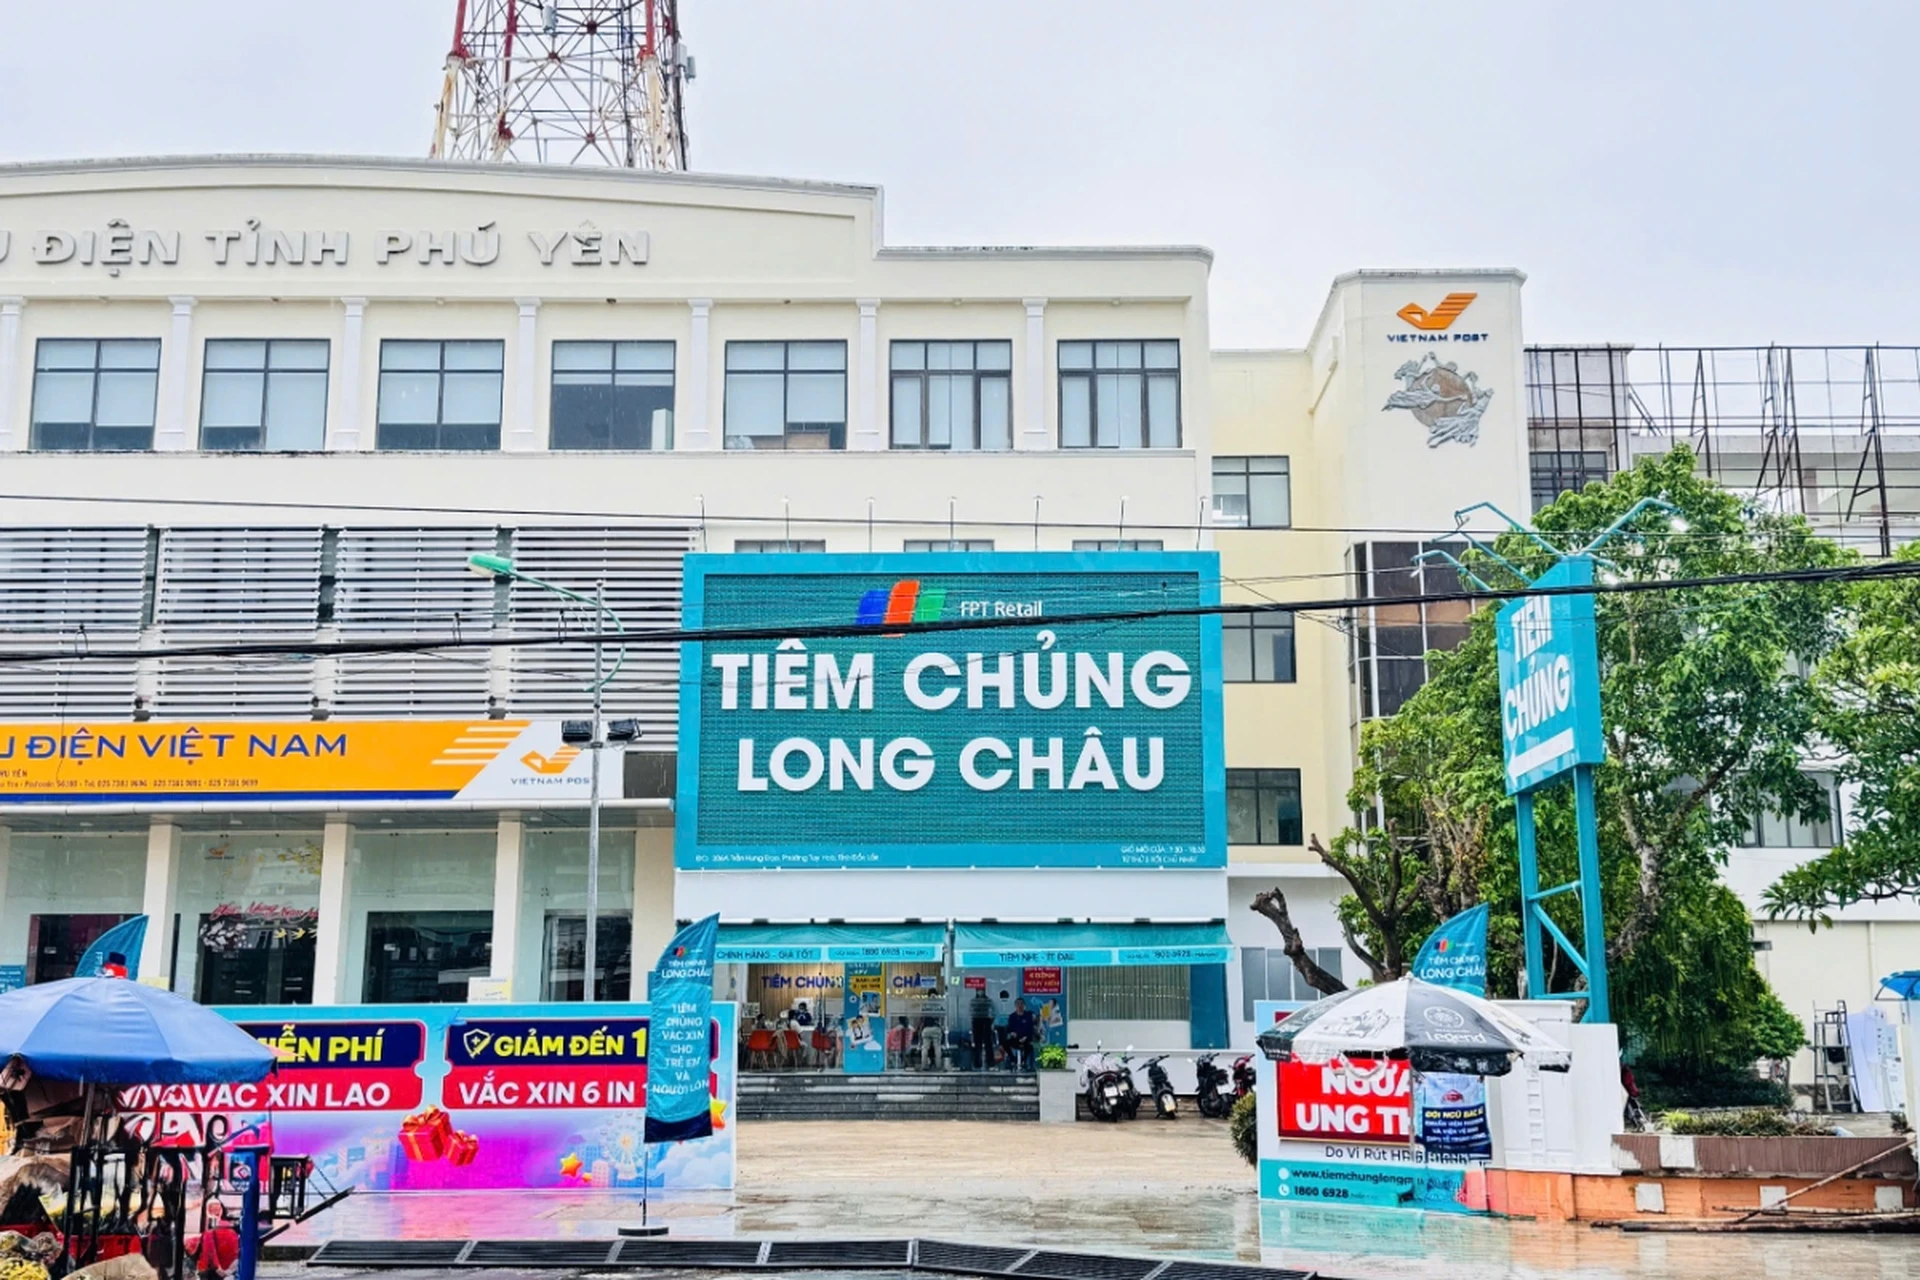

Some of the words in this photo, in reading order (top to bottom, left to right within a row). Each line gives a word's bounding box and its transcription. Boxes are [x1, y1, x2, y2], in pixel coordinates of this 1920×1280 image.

[32, 218, 180, 277] ĐIỆN
[205, 217, 349, 266] TỈNH
[375, 221, 500, 266] PHÚ
[1386, 333, 1449, 343] VIETNAM
[1453, 333, 1489, 342] POST
[960, 601, 988, 617] FPT
[994, 600, 1042, 617] Retail
[711, 638, 874, 710] TIÊM
[903, 630, 1192, 710] CHỦNG
[1504, 654, 1570, 741] CHỦNG
[25, 727, 126, 765] ĐIỆN
[137, 727, 235, 765] VIỆT
[248, 733, 347, 757] NAM
[737, 737, 936, 791] LONG
[959, 726, 1164, 791] CHÂU
[511, 777, 563, 785] VIETNAM
[761, 973, 792, 988] TIÊM
[1420, 968, 1454, 980] LONG
[328, 1028, 386, 1062] PHÍ
[494, 1028, 564, 1057] GIẢM
[568, 1026, 624, 1056] ĐẾN
[670, 1044, 693, 1054] CHO
[1425, 1031, 1487, 1044] Legend
[265, 1083, 318, 1106] XIN
[325, 1082, 391, 1106] LAO
[459, 1070, 520, 1105] VẮC
[527, 1081, 577, 1105] XIN
[582, 1081, 601, 1104] 6
[607, 1081, 635, 1104] IN
[1295, 1102, 1370, 1134] UNG
[1325, 1146, 1344, 1158] Do
[1347, 1147, 1360, 1159] Vi
[1364, 1146, 1387, 1161] Rút
[1294, 1186, 1319, 1197] 1800
[1322, 1187, 1349, 1199] 6928
